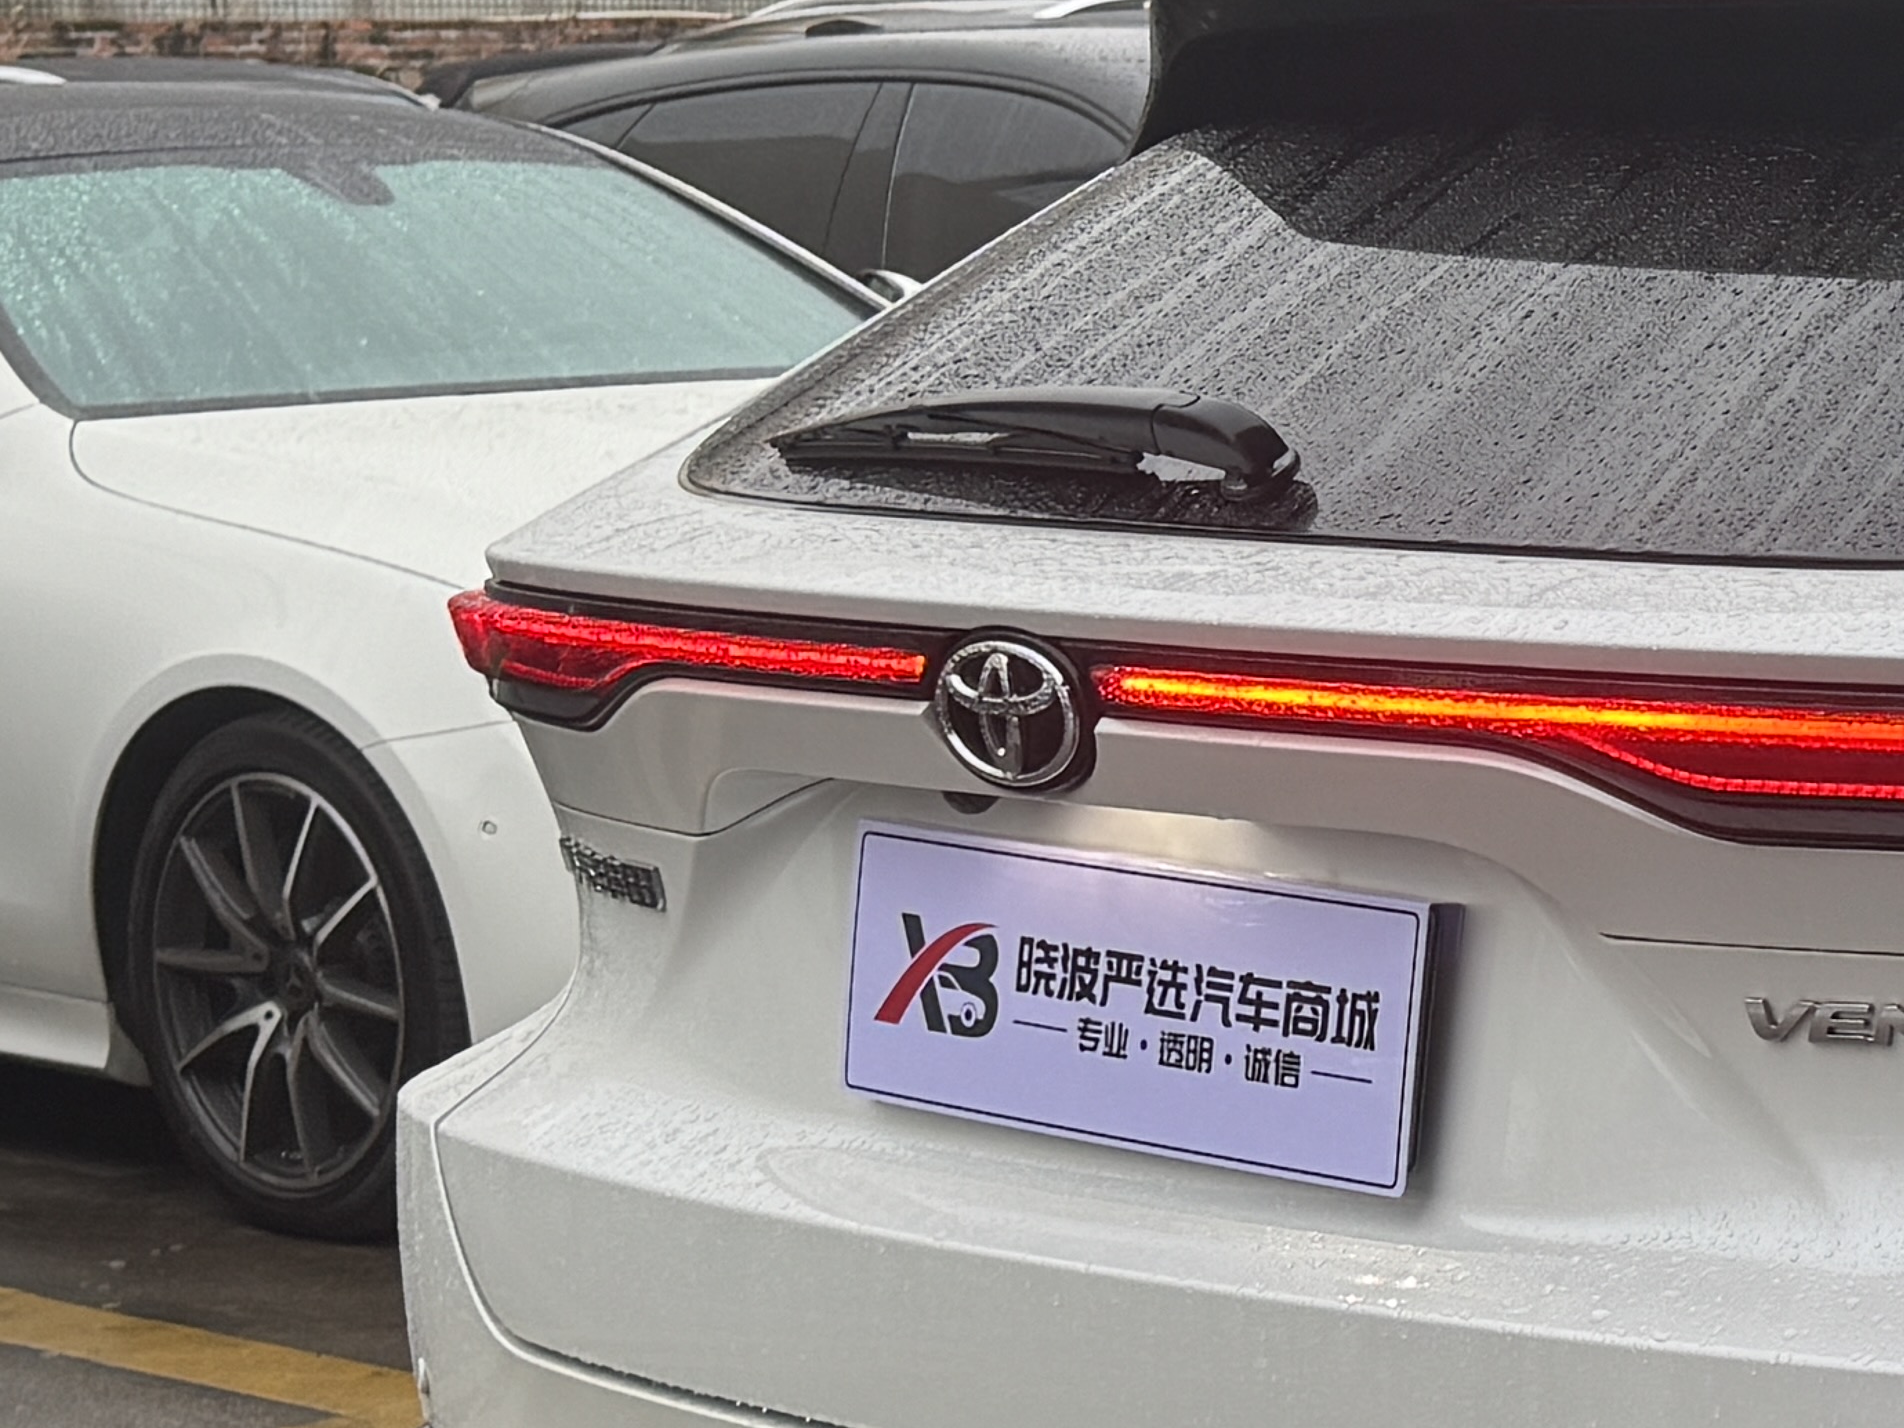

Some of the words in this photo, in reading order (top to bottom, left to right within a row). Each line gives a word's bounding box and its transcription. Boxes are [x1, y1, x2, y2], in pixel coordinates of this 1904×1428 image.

[1015, 935, 1380, 1052] 晓波严选汽车商城
